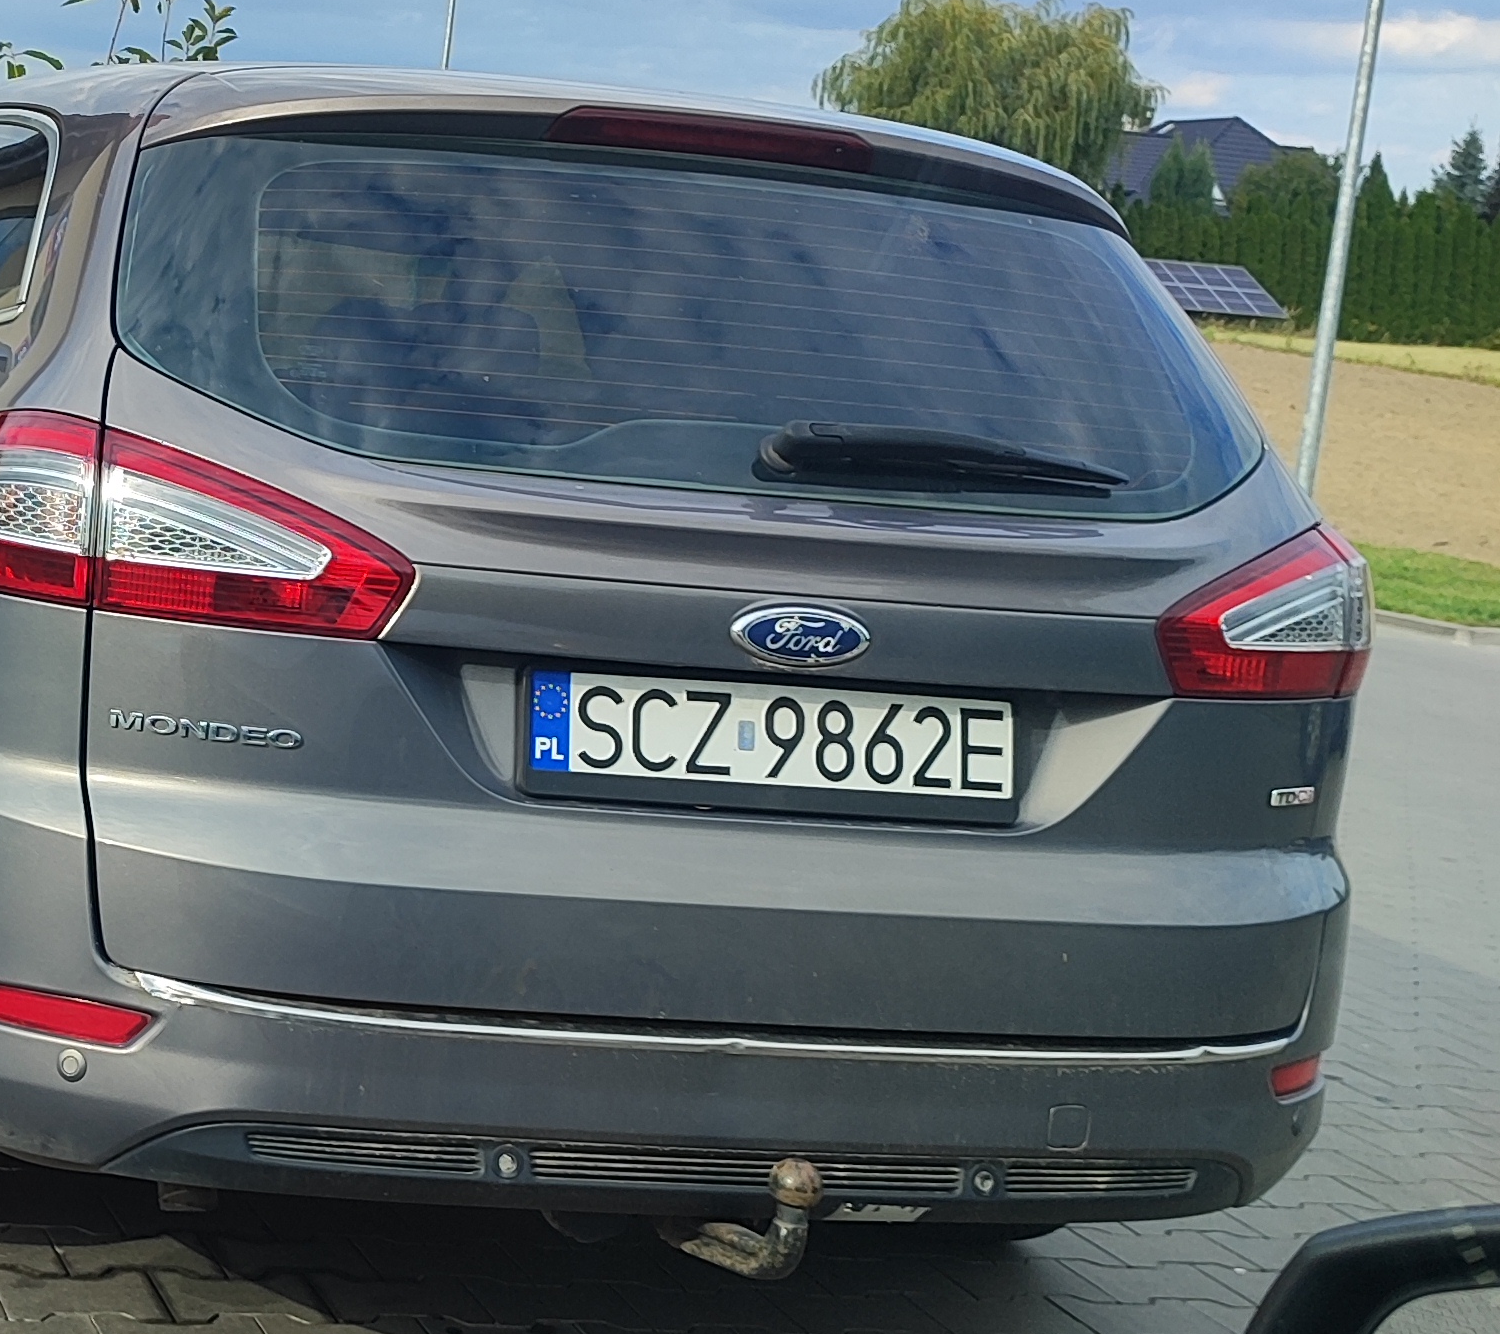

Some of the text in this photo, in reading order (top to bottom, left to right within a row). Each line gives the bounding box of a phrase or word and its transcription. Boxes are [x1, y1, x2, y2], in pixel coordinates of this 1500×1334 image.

[765, 616, 842, 654] Ford
[109, 708, 304, 749] MONDEO
[577, 685, 1004, 793] SCZ 9862E
[534, 736, 565, 762] PL
